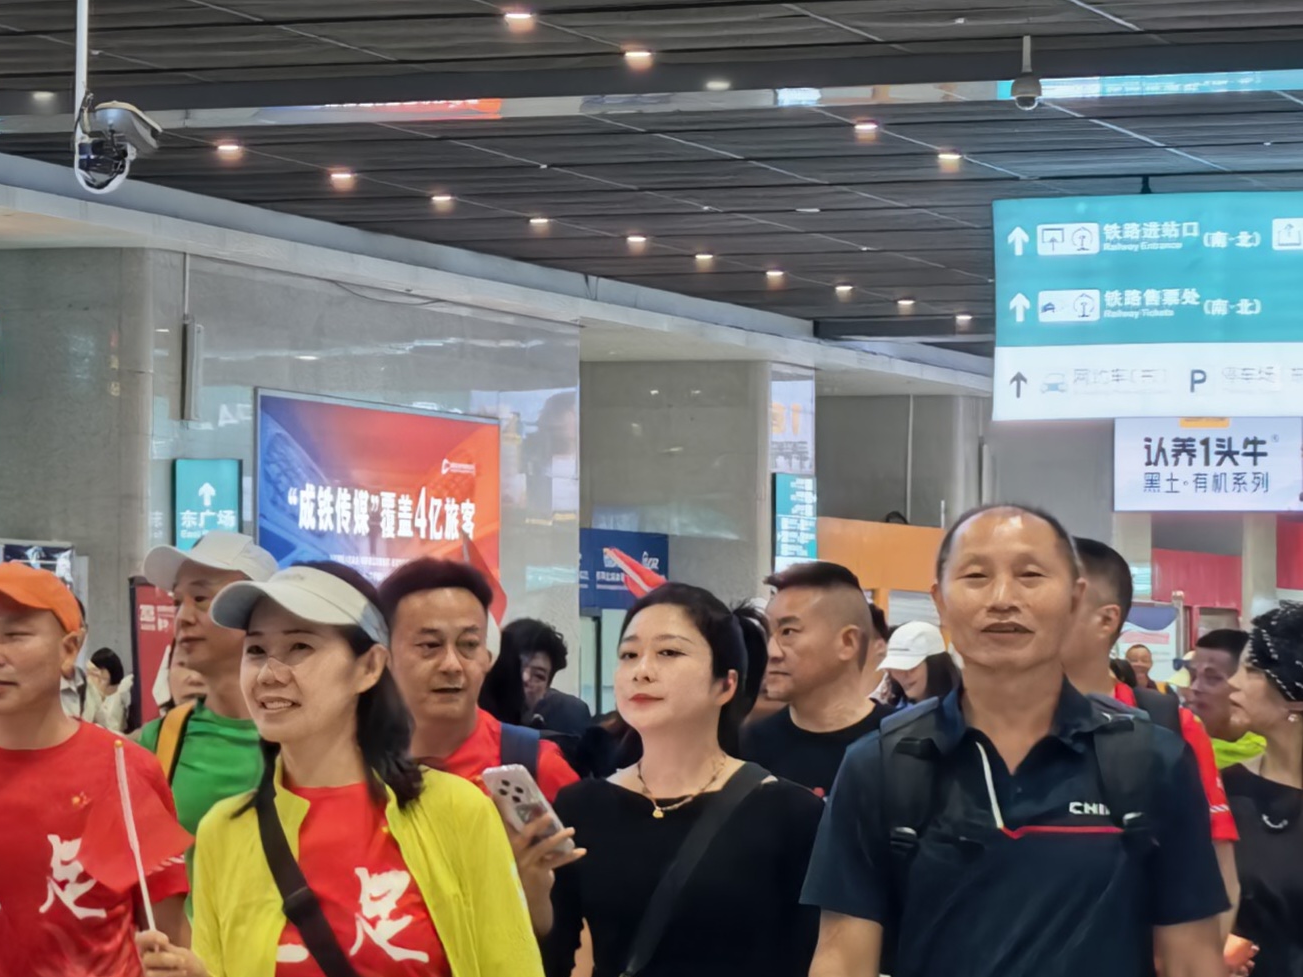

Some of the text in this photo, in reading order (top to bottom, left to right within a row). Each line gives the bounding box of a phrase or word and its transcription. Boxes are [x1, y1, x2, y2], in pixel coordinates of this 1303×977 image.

[1190, 369, 1207, 393] P
[1143, 436, 1268, 467] 认养1头牛
[179, 509, 237, 528] 东广场
